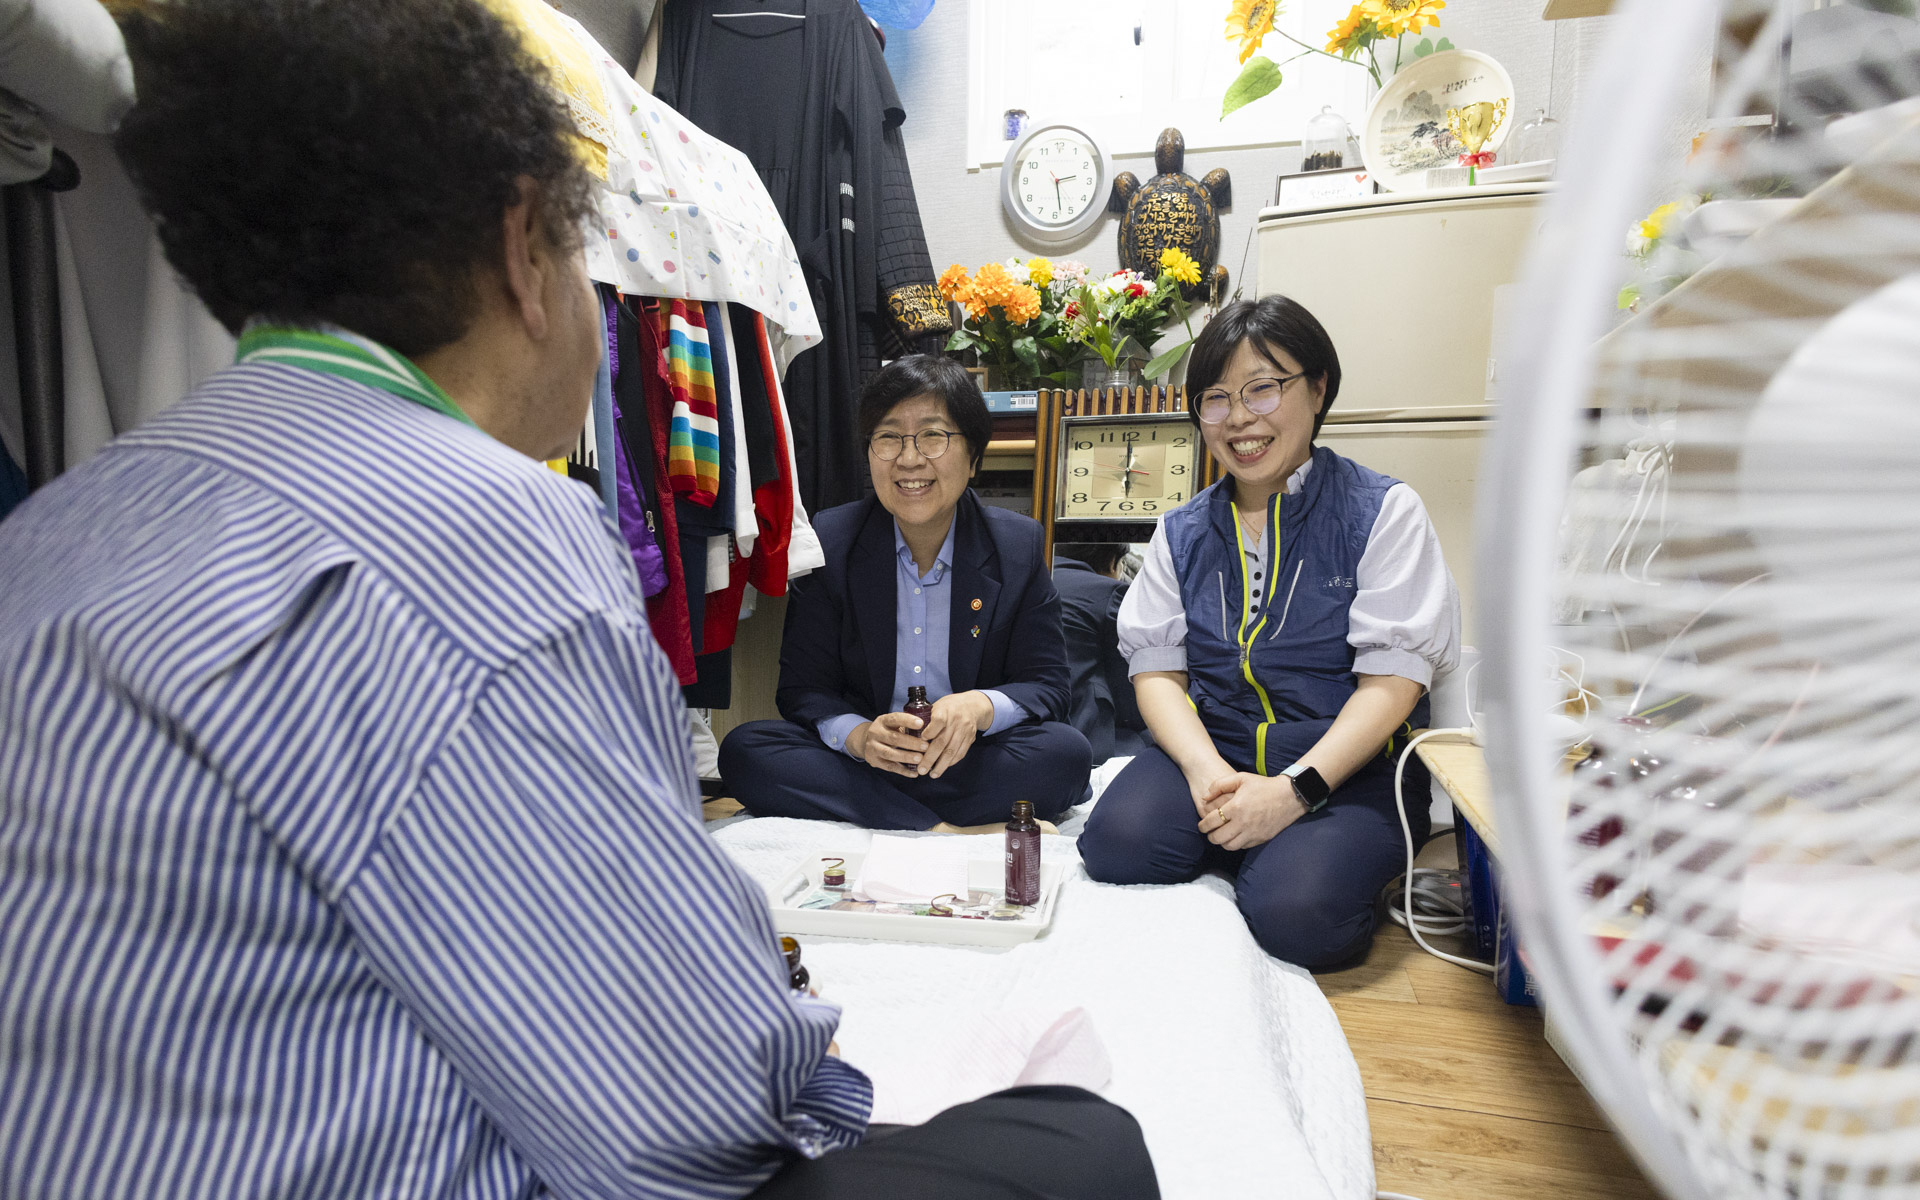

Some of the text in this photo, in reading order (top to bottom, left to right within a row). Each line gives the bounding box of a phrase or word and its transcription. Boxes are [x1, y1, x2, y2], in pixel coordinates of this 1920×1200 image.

[1148, 193, 1188, 204] 우리집은
[1142, 202, 1170, 213] 서로를
[1138, 212, 1198, 224] 여기고 언제나
[1164, 234, 1192, 248] 나누는
[1101, 433, 1113, 442] 11
[1122, 432, 1140, 442] 12
[1152, 431, 1156, 440] 1
[1075, 441, 1093, 450] 10
[1173, 438, 1187, 447] 2
[1074, 468, 1088, 477] 9
[1171, 465, 1185, 475] 3
[1072, 493, 1087, 503] 8
[1167, 492, 1184, 502] 4
[1097, 502, 1110, 511] 7
[1119, 502, 1134, 511] 6
[1143, 501, 1157, 511] 5
